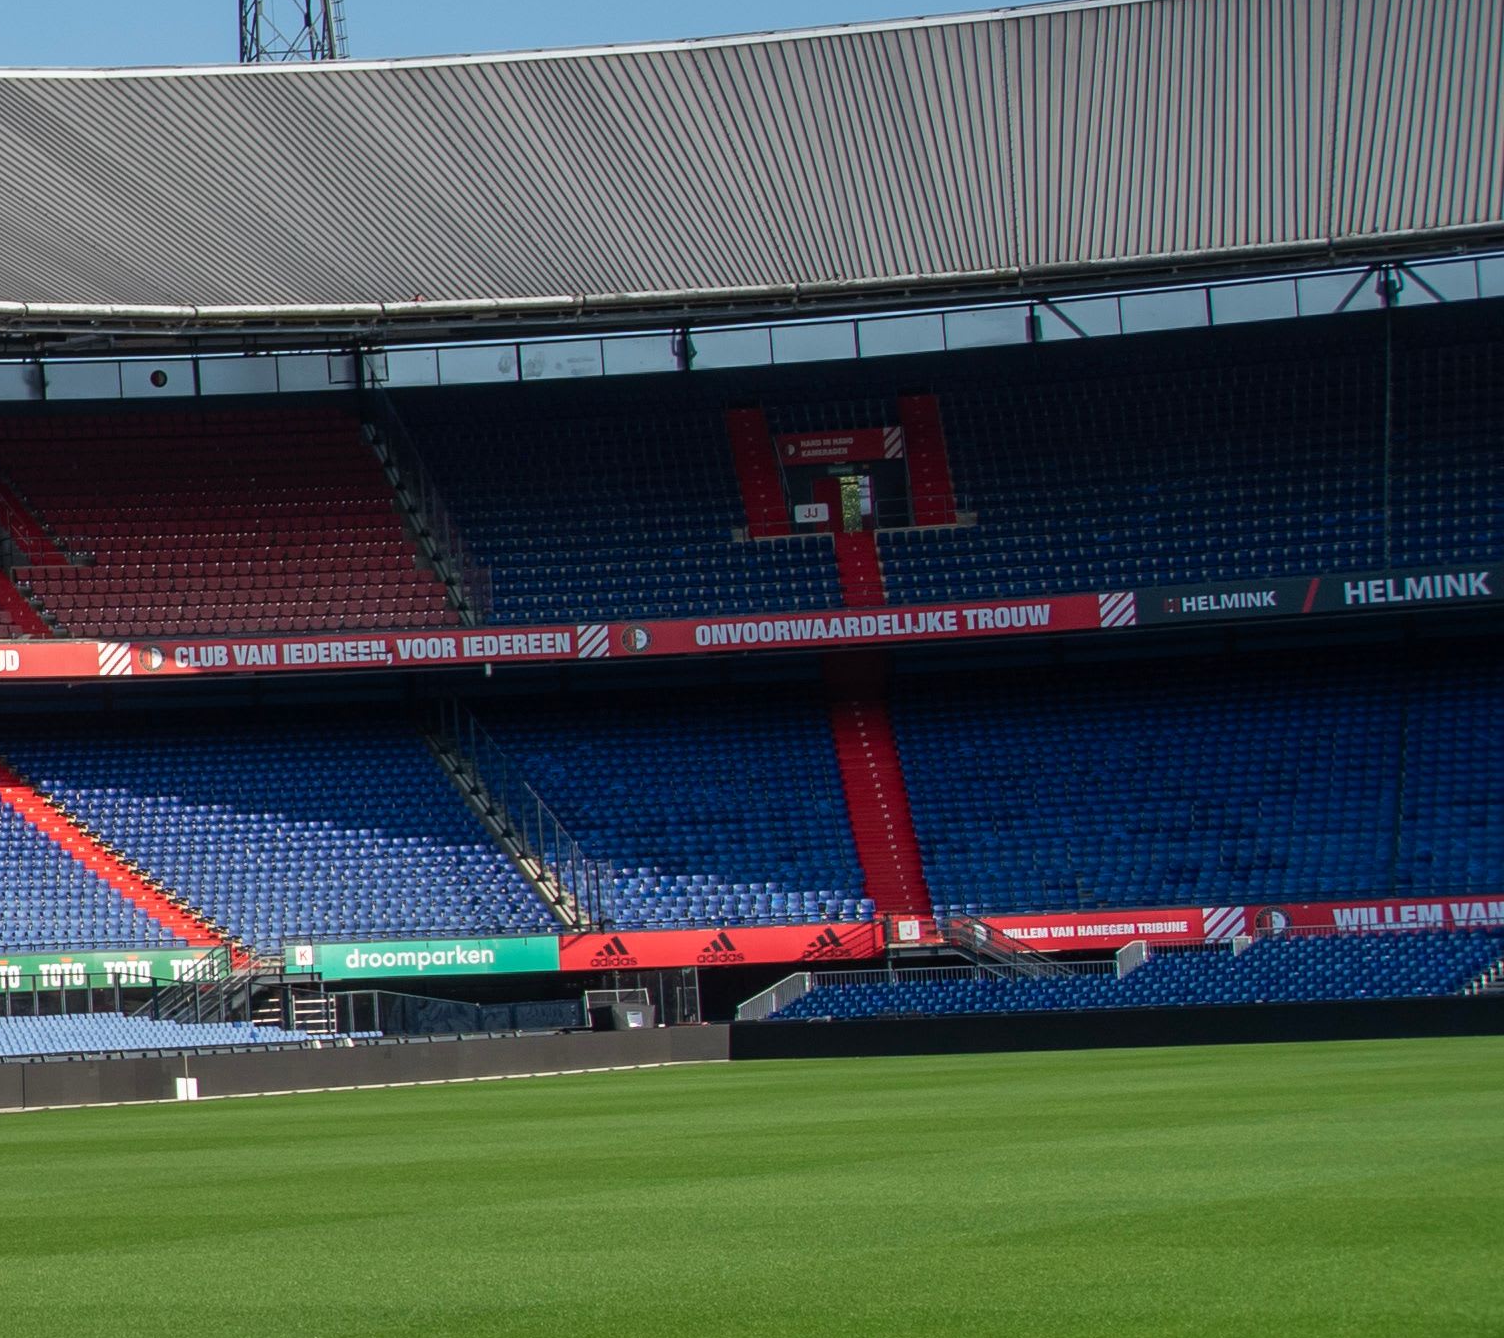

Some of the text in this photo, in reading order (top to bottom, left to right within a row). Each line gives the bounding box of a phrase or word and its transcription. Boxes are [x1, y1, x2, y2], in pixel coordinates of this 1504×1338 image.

[1182, 590, 1277, 613] HELMINK
[1344, 571, 1492, 605] HELMINK
[695, 603, 1051, 647] ONVOORWAARDELIJKE TROUW
[174, 632, 571, 668] CLUB VAN IEDEREEN, VOOR IEDEREEN
[1333, 901, 1504, 931] WILLEM VAN
[1002, 921, 1188, 940] WILLEM VAN HANEGEM TRIBUNE
[345, 945, 494, 970] droomparken
[591, 952, 745, 967] adidas adidas
[39, 963, 85, 987] TOTO
[103, 960, 152, 985] TOTO
